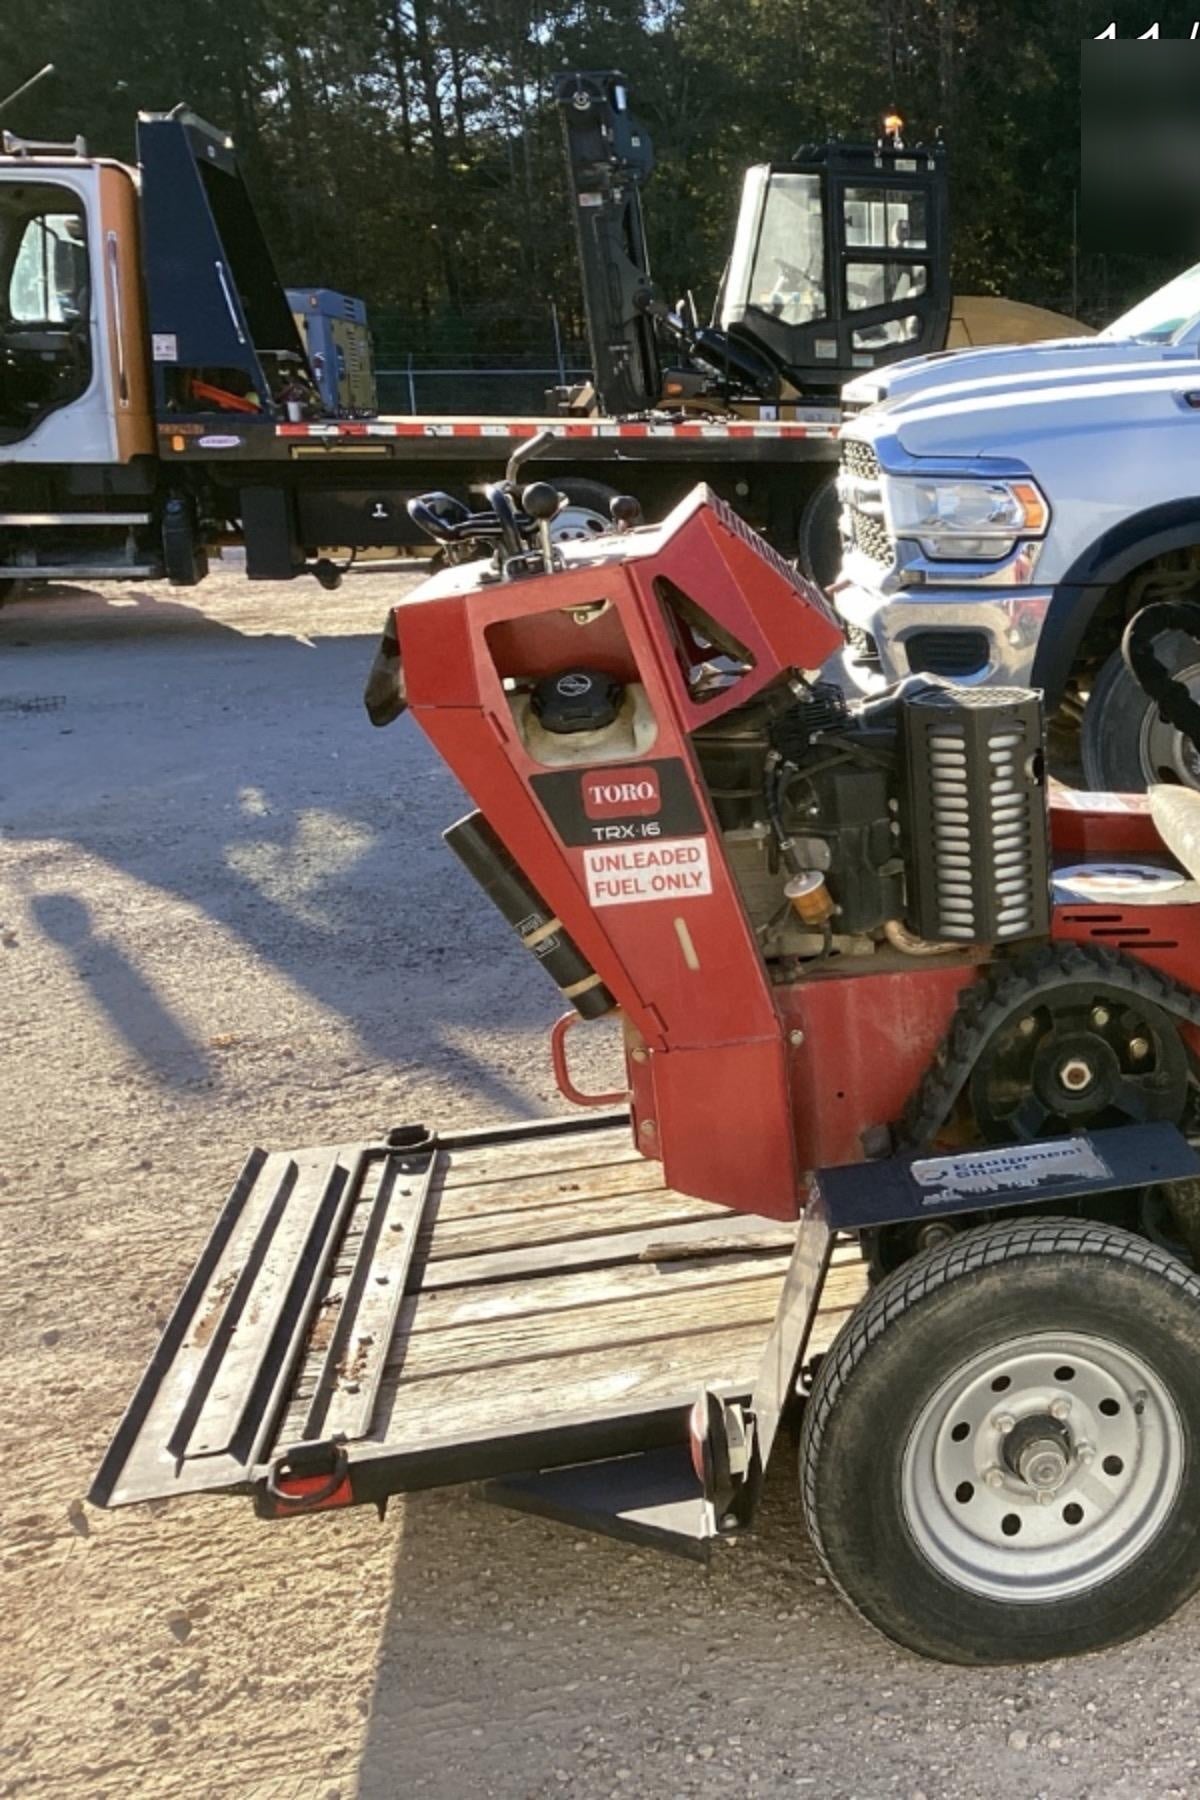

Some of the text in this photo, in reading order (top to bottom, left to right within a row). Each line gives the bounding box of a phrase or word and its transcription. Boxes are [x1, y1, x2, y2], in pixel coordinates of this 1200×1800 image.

[588, 781, 655, 805] TORO
[591, 847, 701, 873] UNLEADED
[595, 871, 704, 898] FUEL ONLY
